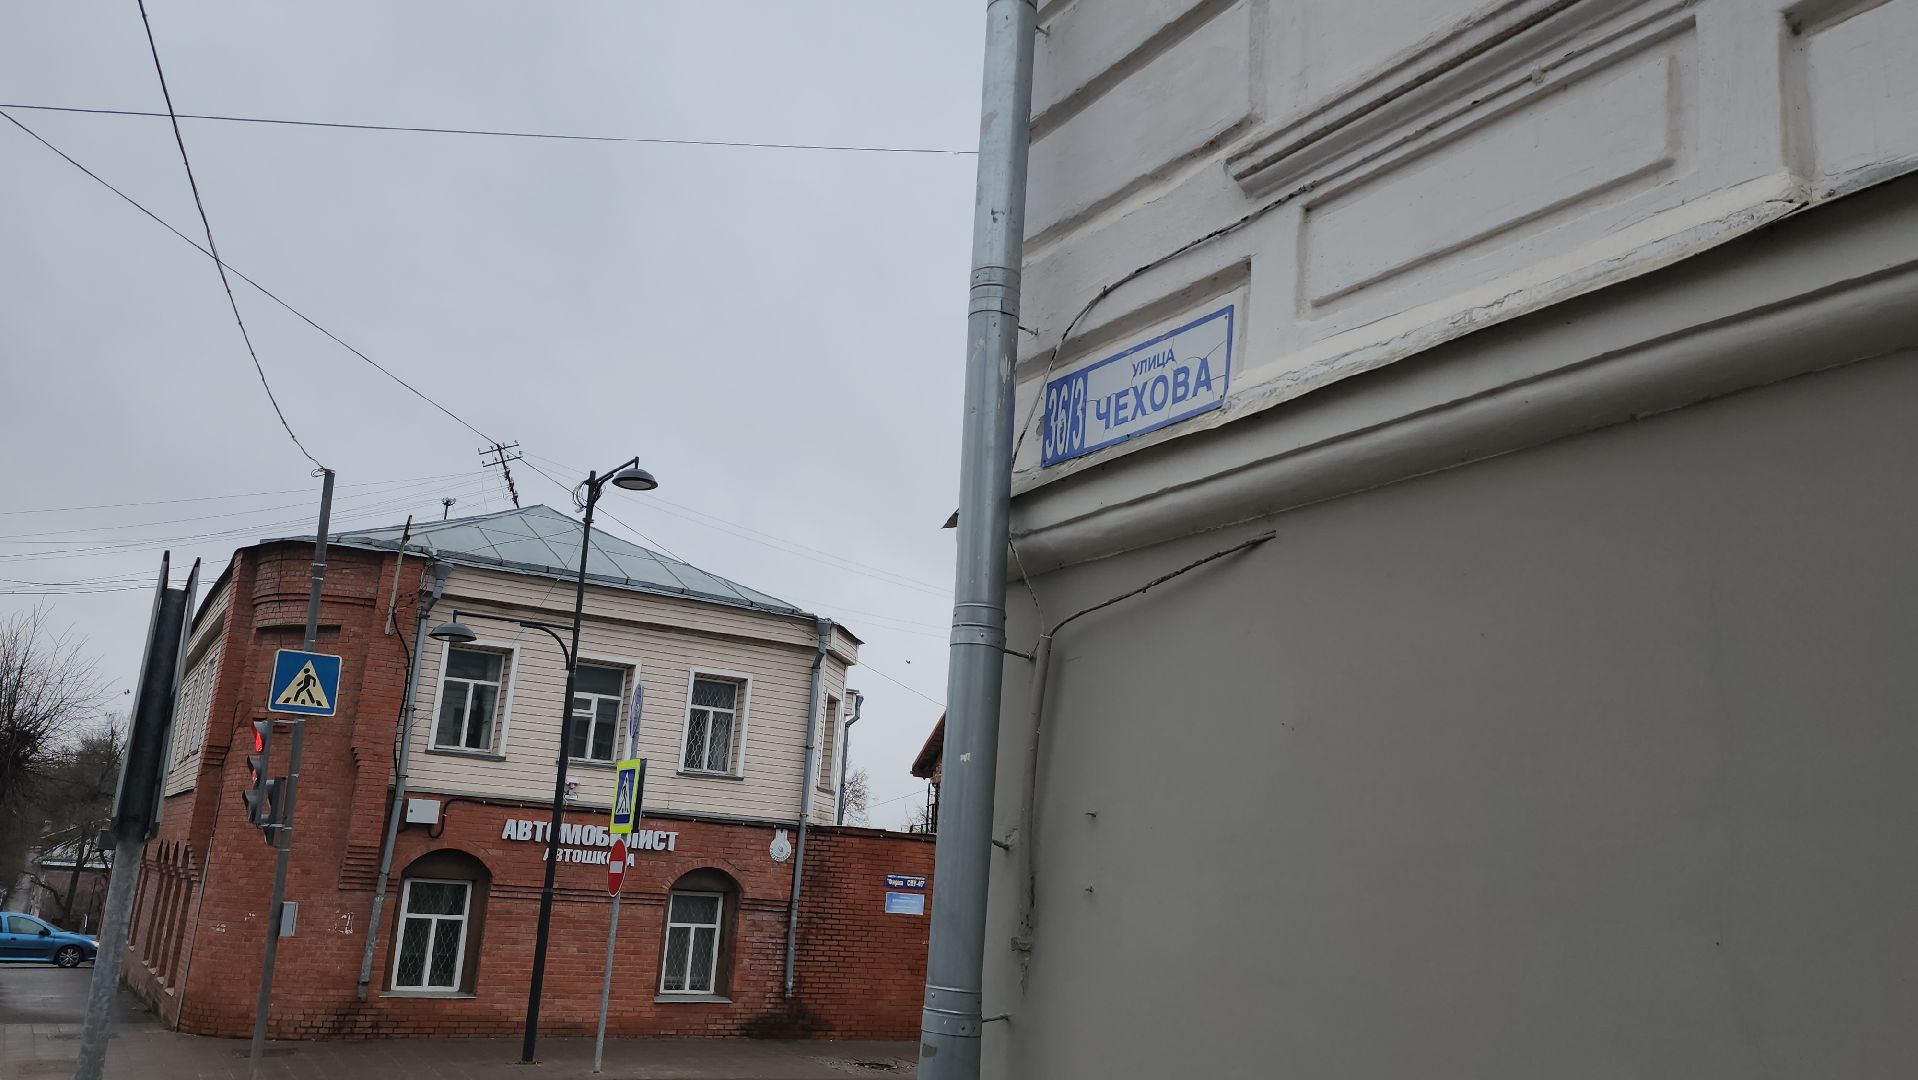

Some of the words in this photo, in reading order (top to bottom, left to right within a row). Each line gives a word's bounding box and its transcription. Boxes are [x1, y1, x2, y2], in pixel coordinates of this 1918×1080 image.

[1132, 348, 1176, 377] УЛИЦА
[1045, 377, 1085, 459] 36/3
[1095, 357, 1212, 430] ЧЕХОВА
[542, 847, 635, 867] АВТОШКА
